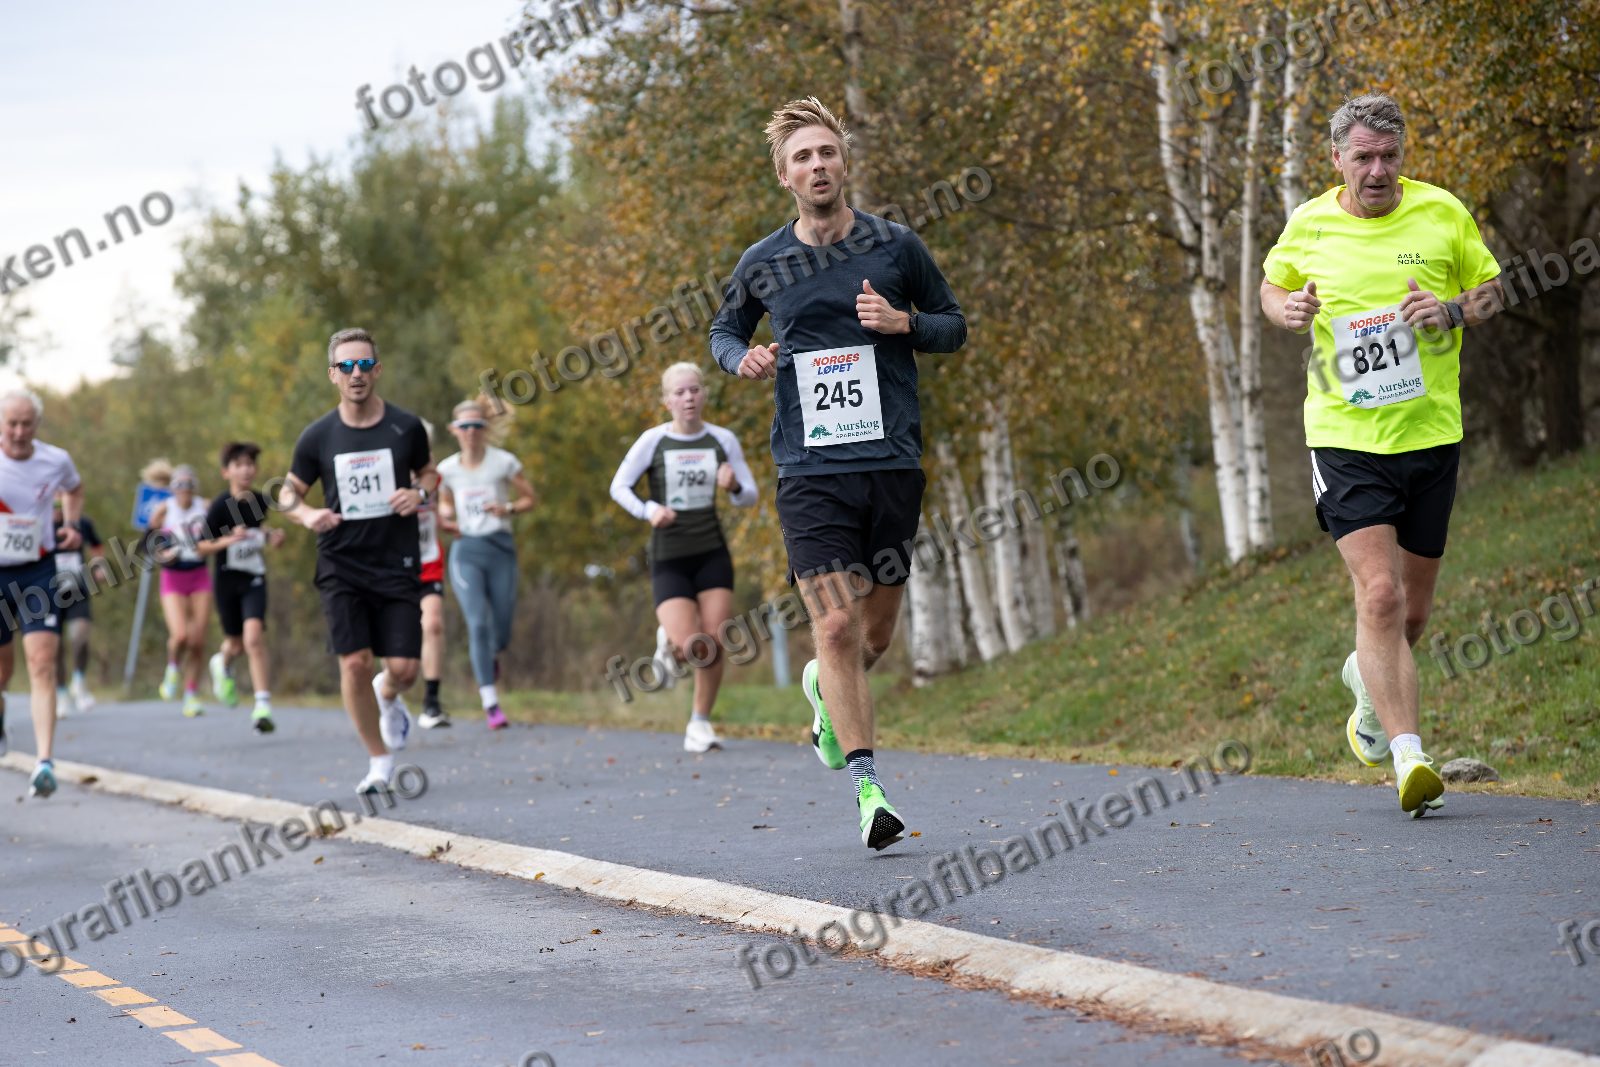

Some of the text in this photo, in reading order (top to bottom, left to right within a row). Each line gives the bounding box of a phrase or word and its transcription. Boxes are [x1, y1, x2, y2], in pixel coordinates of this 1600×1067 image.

[1348, 312, 1396, 330] NORGES
[1354, 323, 1390, 339] LØPET
[811, 352, 860, 367] NORGES
[1352, 338, 1401, 375] 821
[817, 363, 853, 376] LØPET
[813, 379, 864, 411] 245
[1378, 377, 1422, 395] Aurskog
[835, 419, 880, 432] Aurskog
[348, 473, 382, 496] 341
[677, 469, 707, 488] 792
[3, 532, 34, 552] 760
